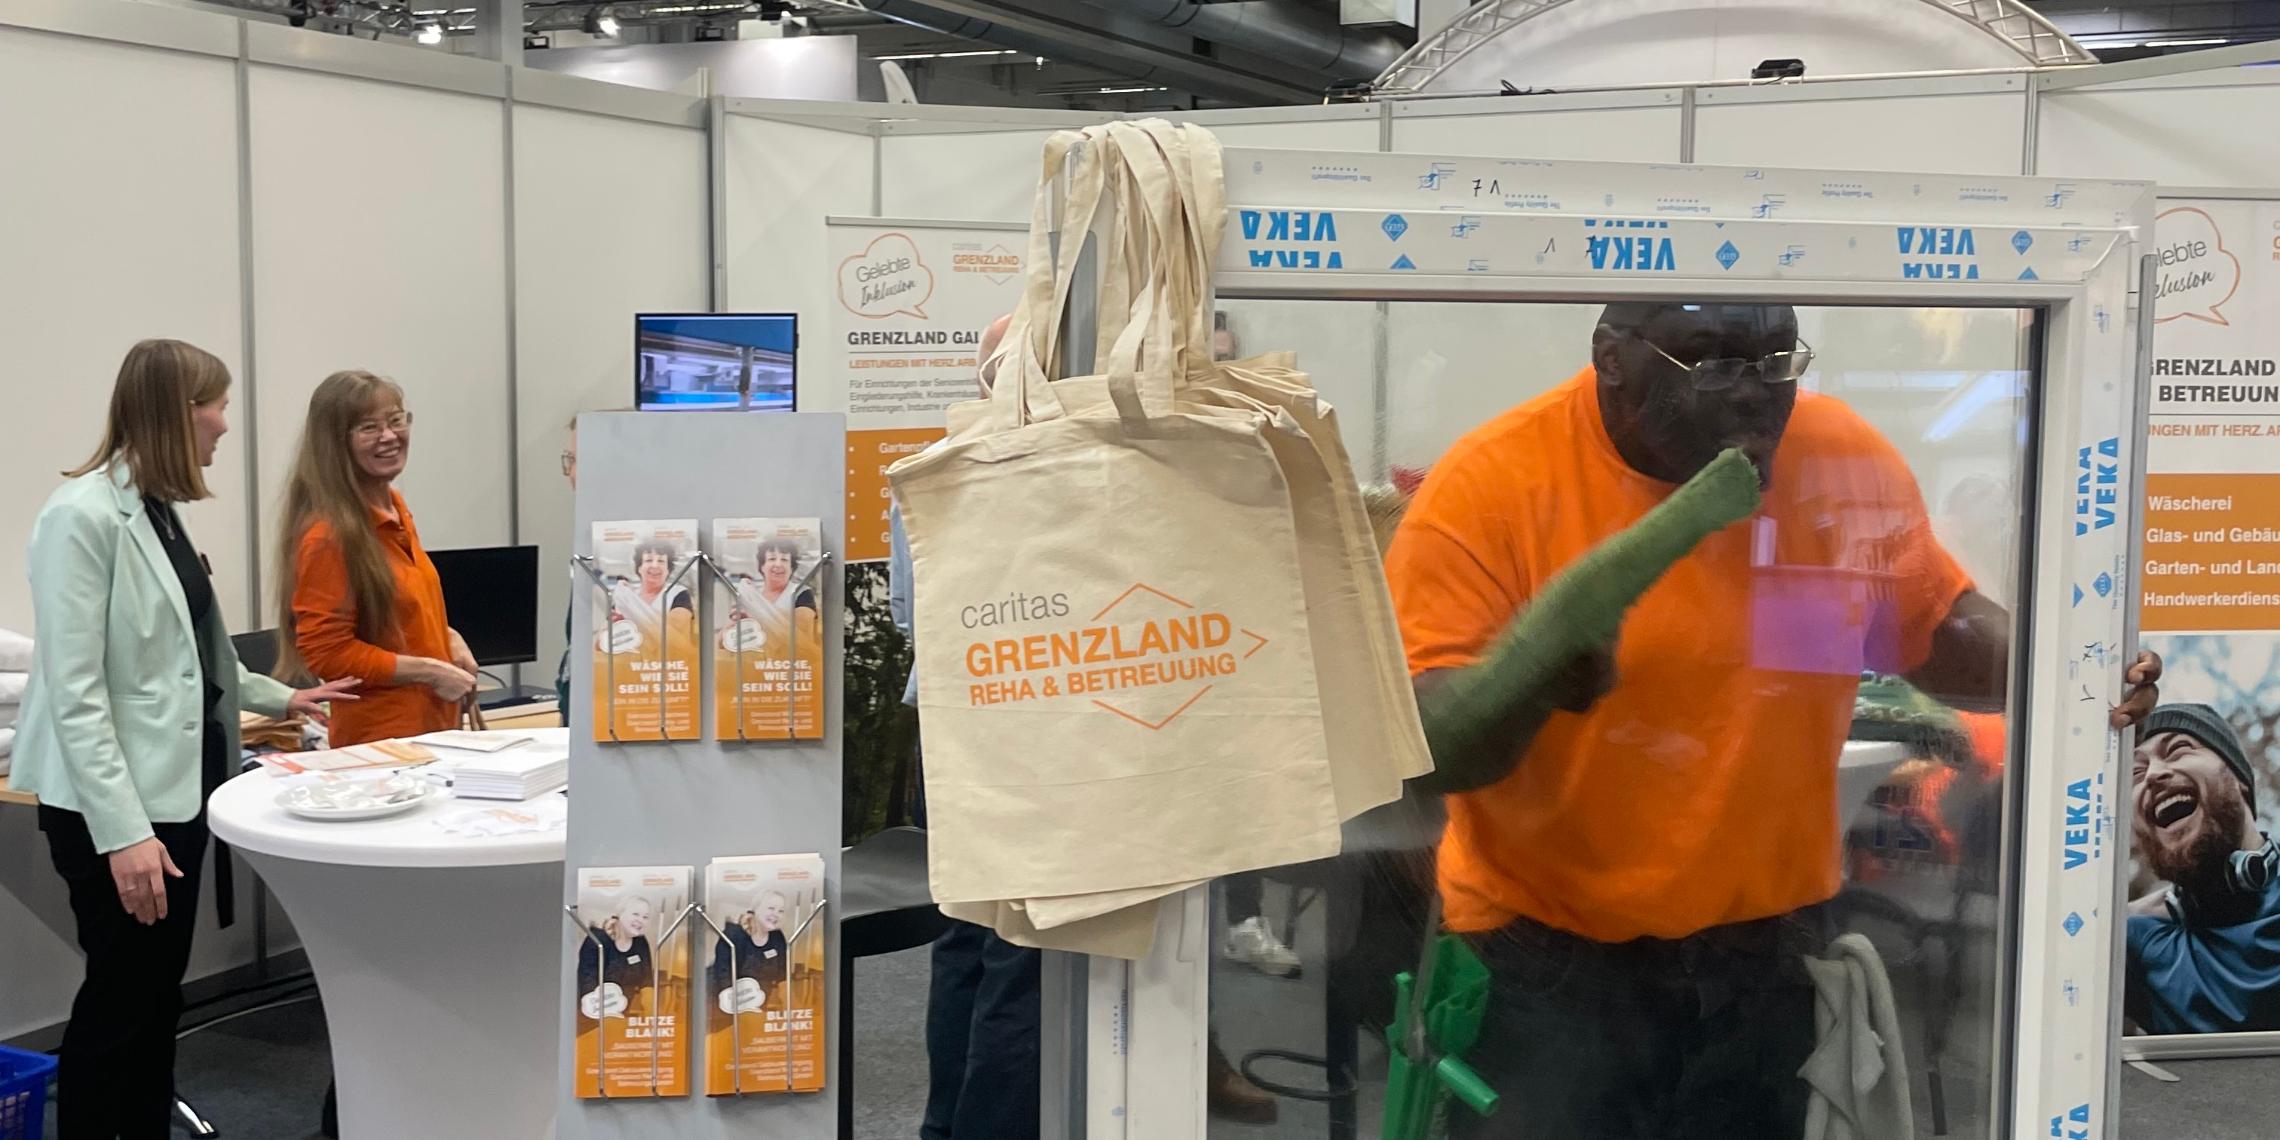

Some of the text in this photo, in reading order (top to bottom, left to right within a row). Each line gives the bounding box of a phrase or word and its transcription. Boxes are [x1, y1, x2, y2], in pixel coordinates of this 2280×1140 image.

[1240, 211, 1337, 242] VEKA
[1590, 236, 1675, 270] VEKA
[1897, 227, 1975, 255] VEKA
[856, 257, 911, 282] Gelebte
[861, 279, 917, 308] Inklusion
[848, 331, 947, 345] GRENZLAND
[2194, 425, 2219, 436] MIT
[2094, 437, 2119, 529] VEKA
[2148, 495, 2232, 511] Wäscherei
[2146, 528, 2188, 543] Glas-
[2193, 528, 2225, 543] und
[2145, 560, 2206, 575] Garten-
[2210, 560, 2242, 575] und
[960, 591, 1070, 629] caritas
[965, 612, 1231, 678] GRENZLAND
[618, 684, 650, 694] SEIN
[742, 682, 772, 692] SEIN
[763, 671, 788, 681] WIE
[969, 652, 1237, 706] REHA & BETREUUNG
[2064, 778, 2091, 870] VEKA
